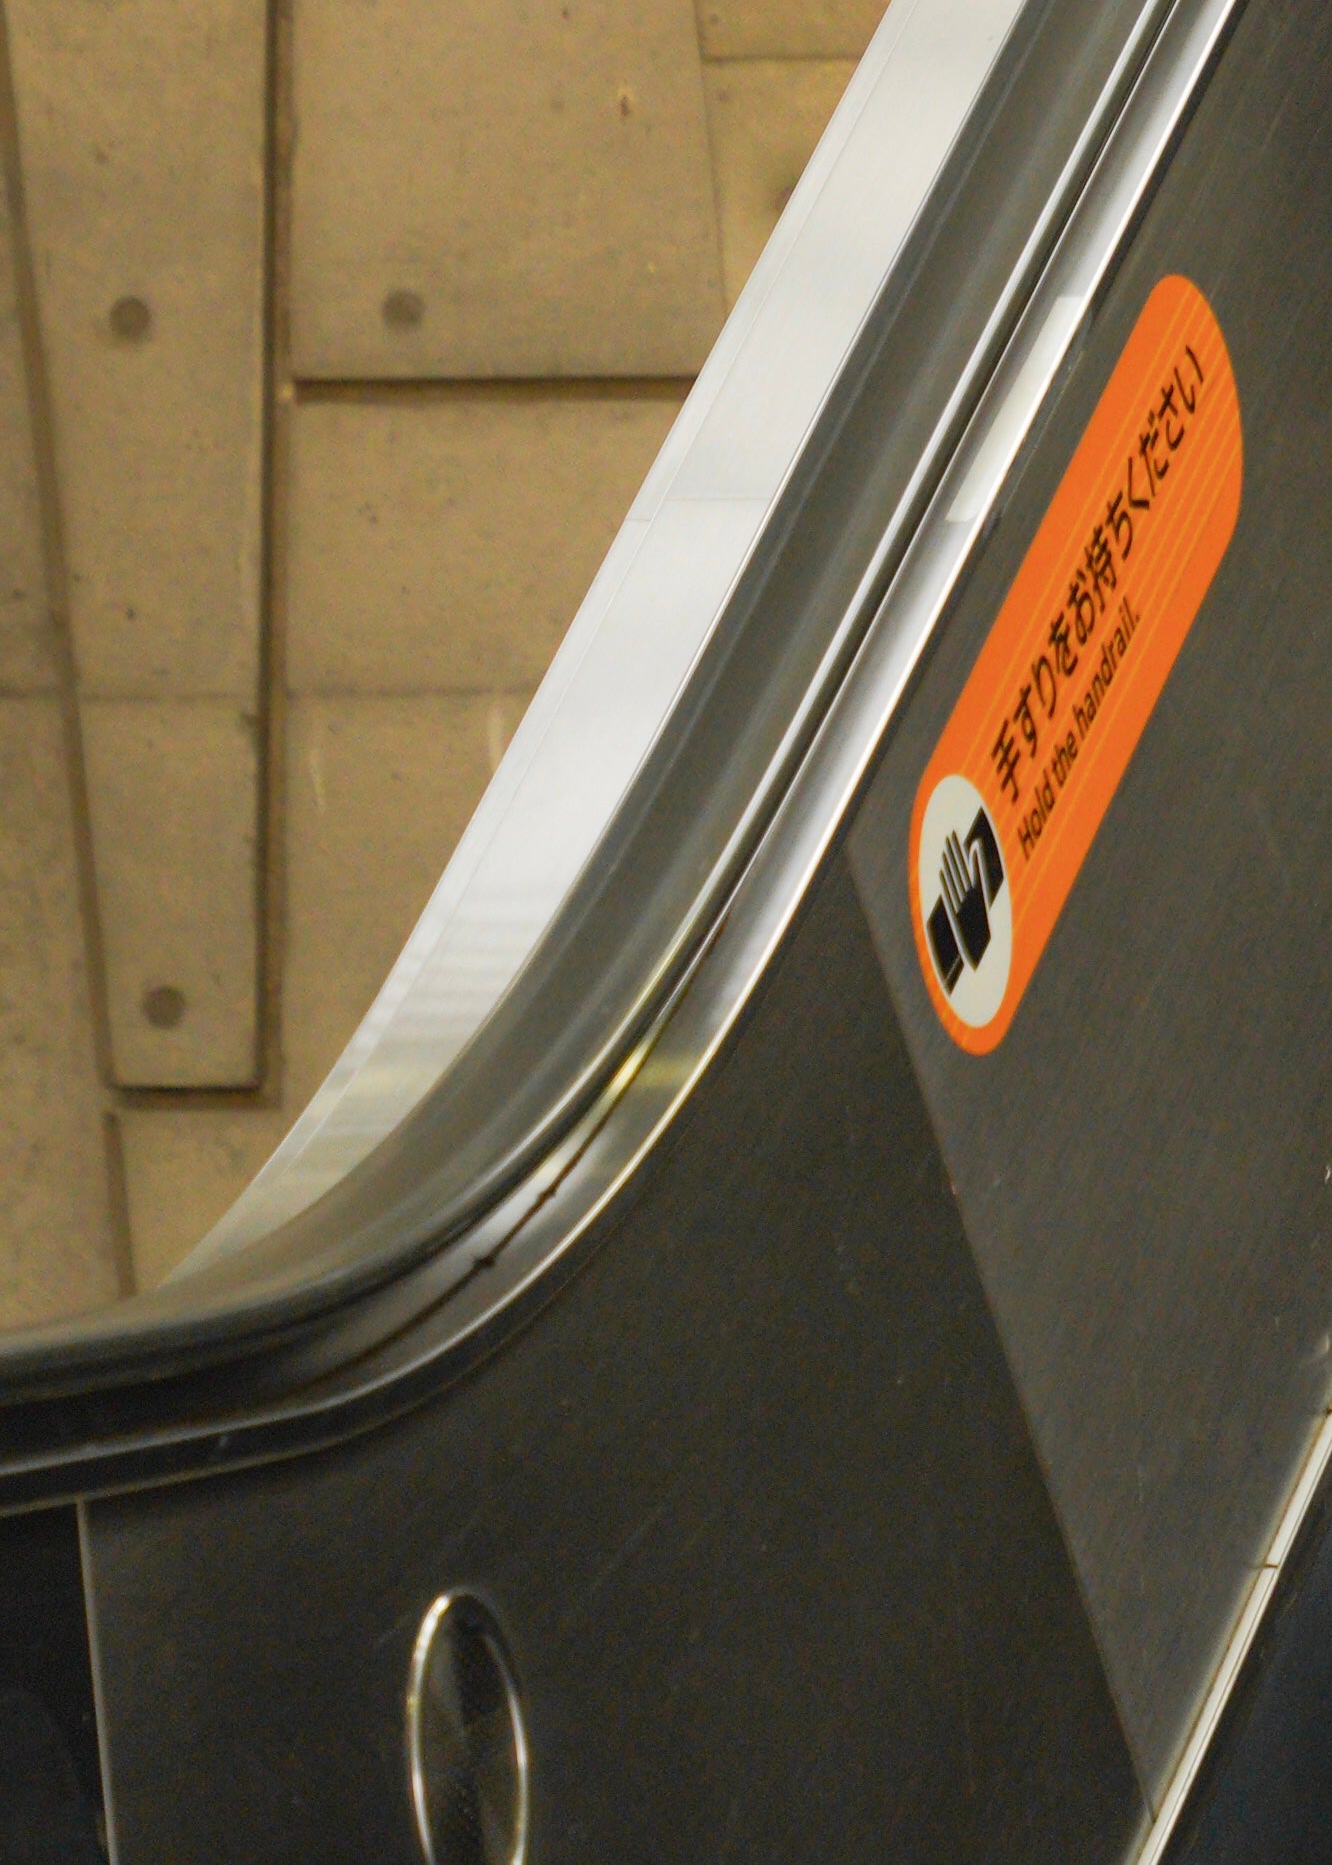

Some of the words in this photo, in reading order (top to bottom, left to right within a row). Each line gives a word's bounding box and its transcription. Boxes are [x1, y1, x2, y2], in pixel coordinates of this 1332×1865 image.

[990, 344, 1204, 806] 手すりをお持ちください
[1017, 768, 1055, 862] Hold
[1051, 730, 1079, 789] the
[1073, 595, 1141, 741] handrail.
